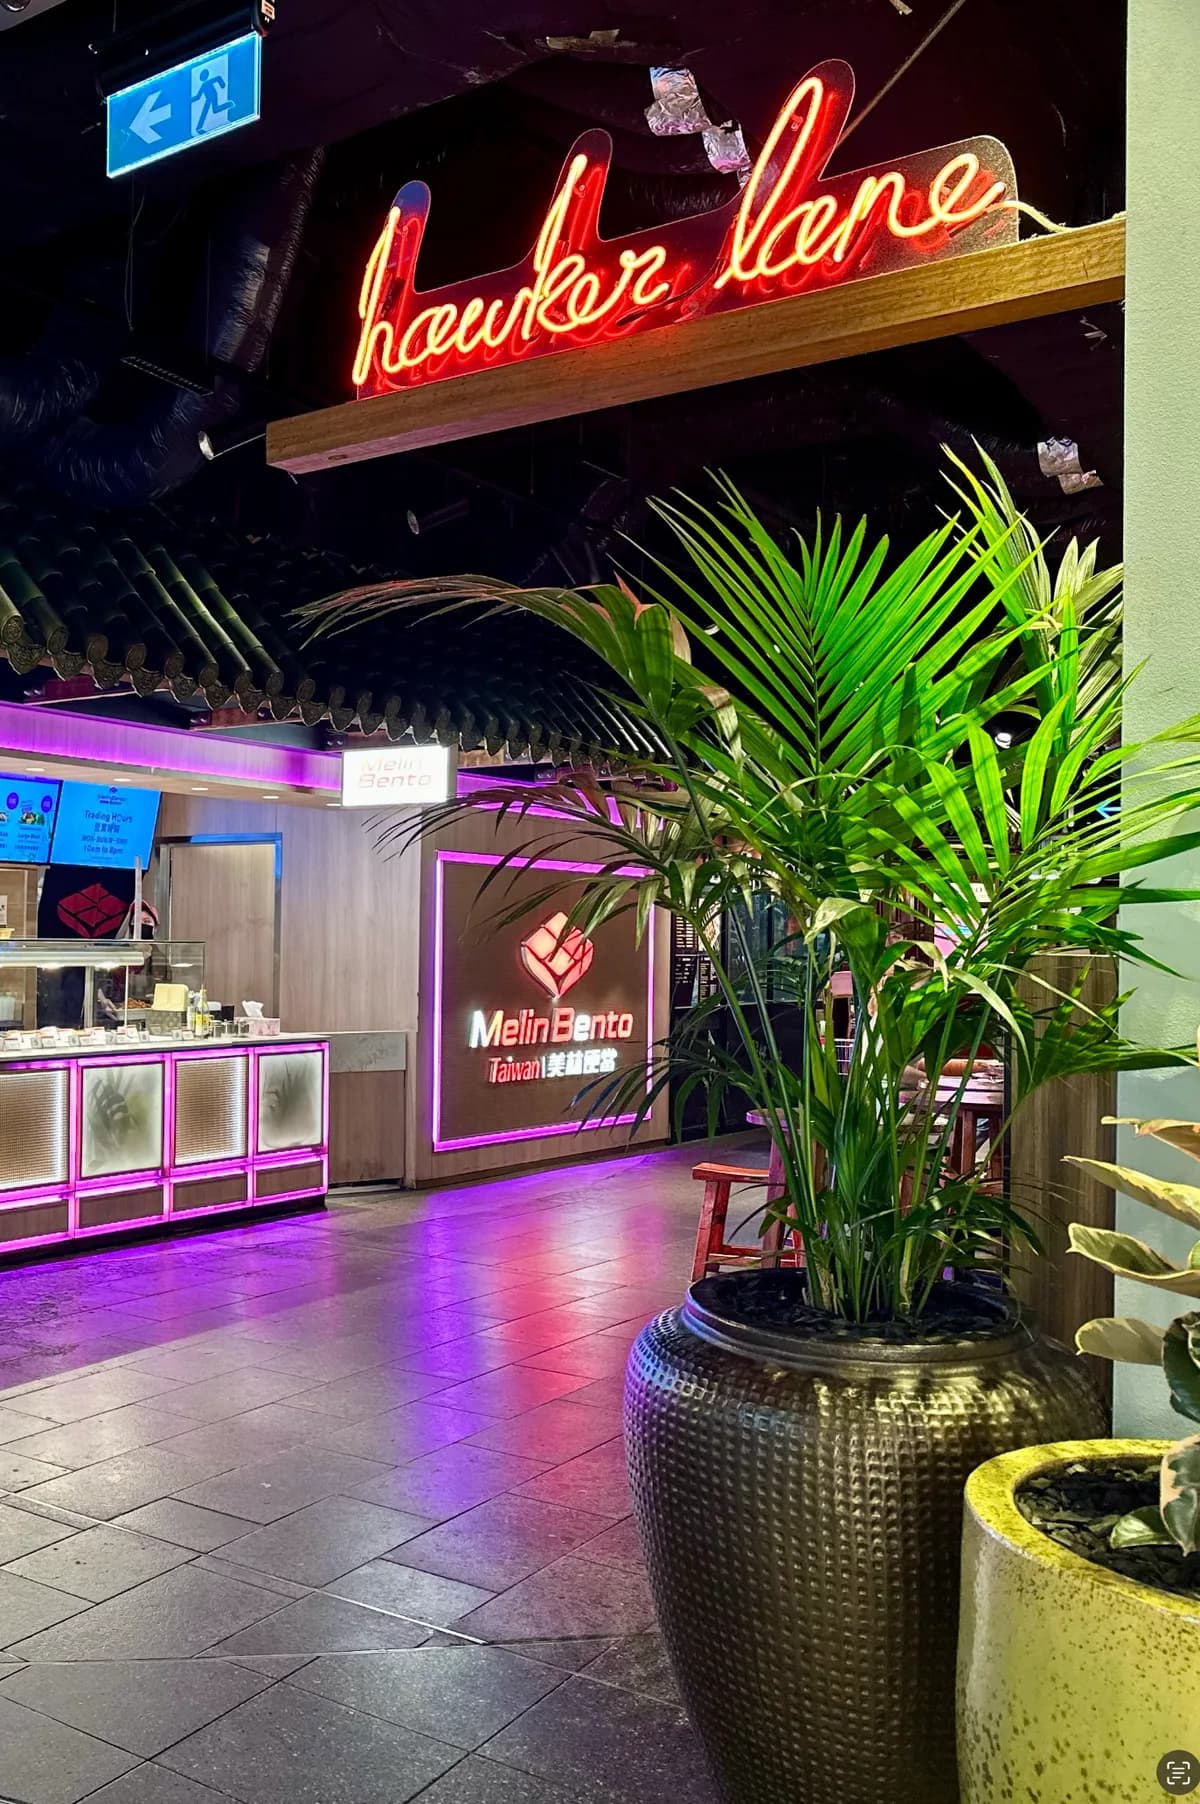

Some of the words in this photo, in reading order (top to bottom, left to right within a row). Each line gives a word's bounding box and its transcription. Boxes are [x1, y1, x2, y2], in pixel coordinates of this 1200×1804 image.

[351, 154, 669, 386] hawker
[714, 76, 1006, 289] lane
[359, 773, 432, 789] Bento
[469, 1009, 549, 1048] Melin
[551, 1007, 633, 1042] Bento
[488, 1055, 540, 1083] Taiwan
